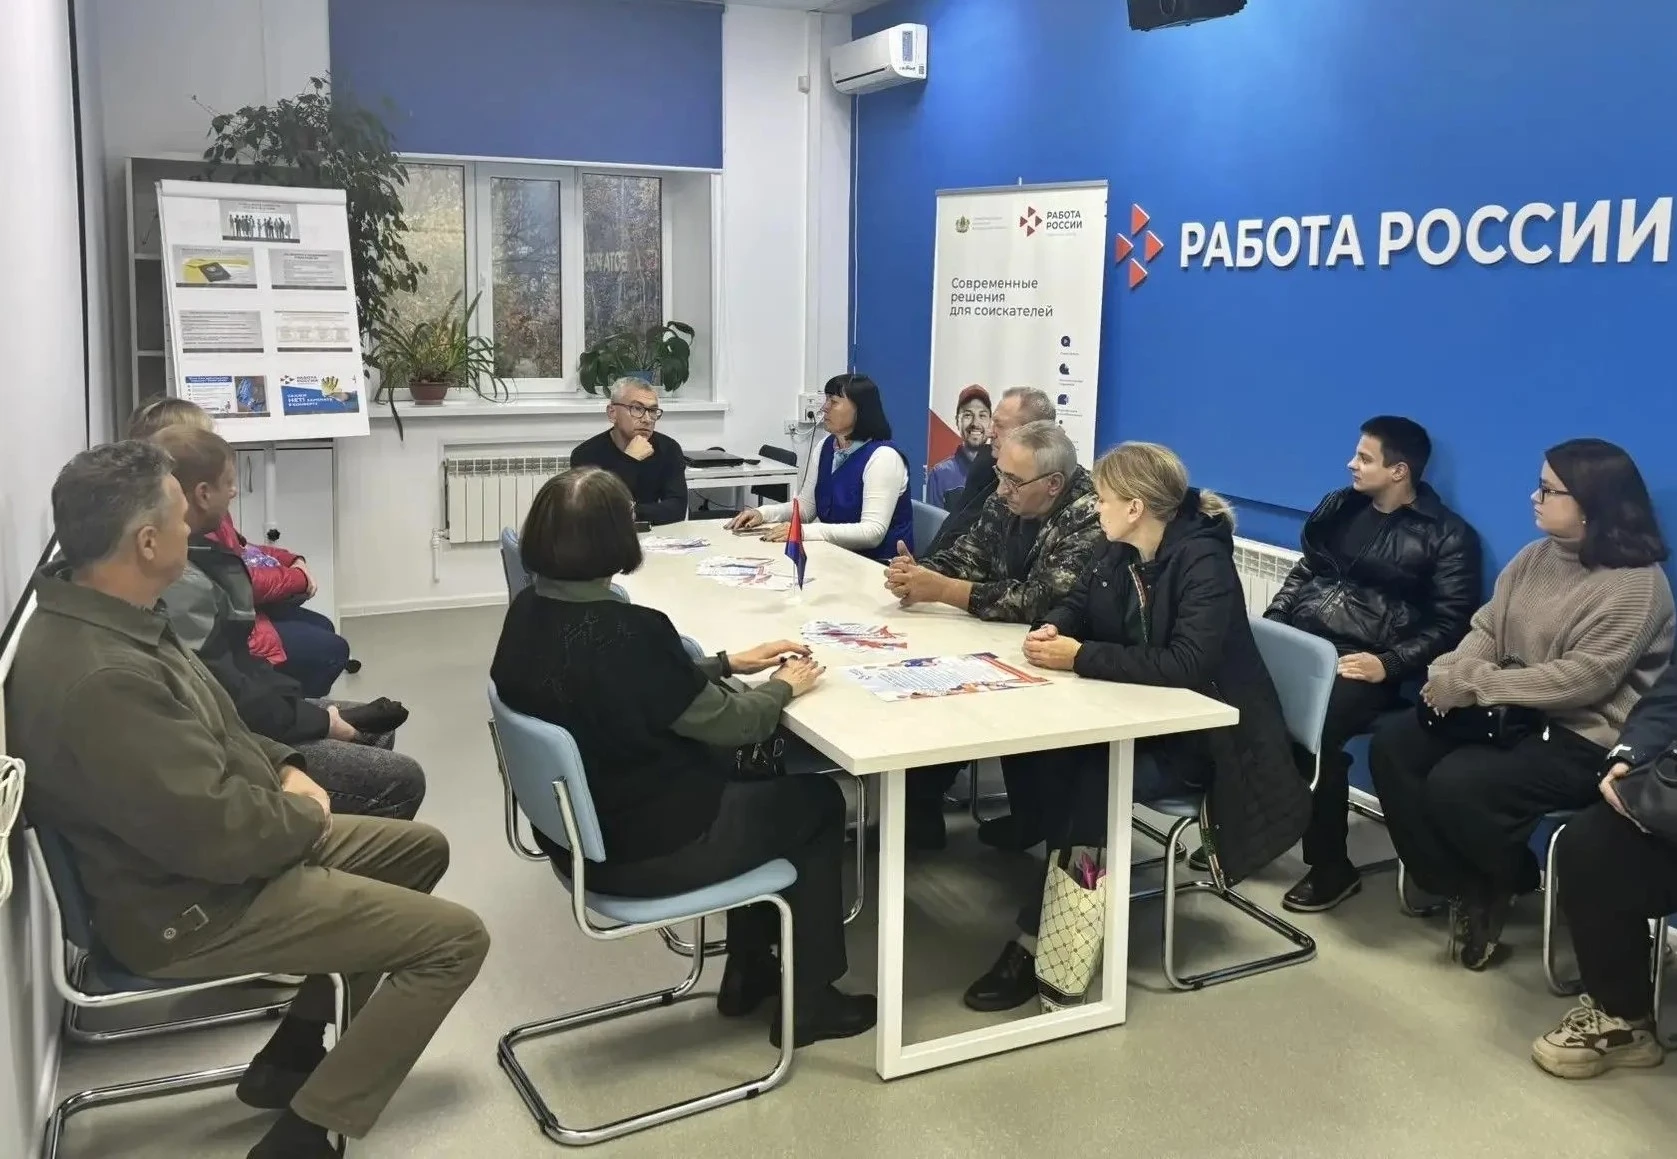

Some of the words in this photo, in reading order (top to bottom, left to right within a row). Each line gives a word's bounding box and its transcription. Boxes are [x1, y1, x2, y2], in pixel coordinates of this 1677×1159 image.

[1046, 210, 1081, 220] РАБОТА
[1046, 220, 1083, 230] РОССИИ
[1180, 213, 1364, 269] РАБОТА
[1378, 197, 1673, 267] РОССИИ
[951, 277, 1039, 291] Современные
[950, 293, 1006, 305] решения
[949, 306, 972, 317] для
[974, 305, 1054, 317] соискателей
